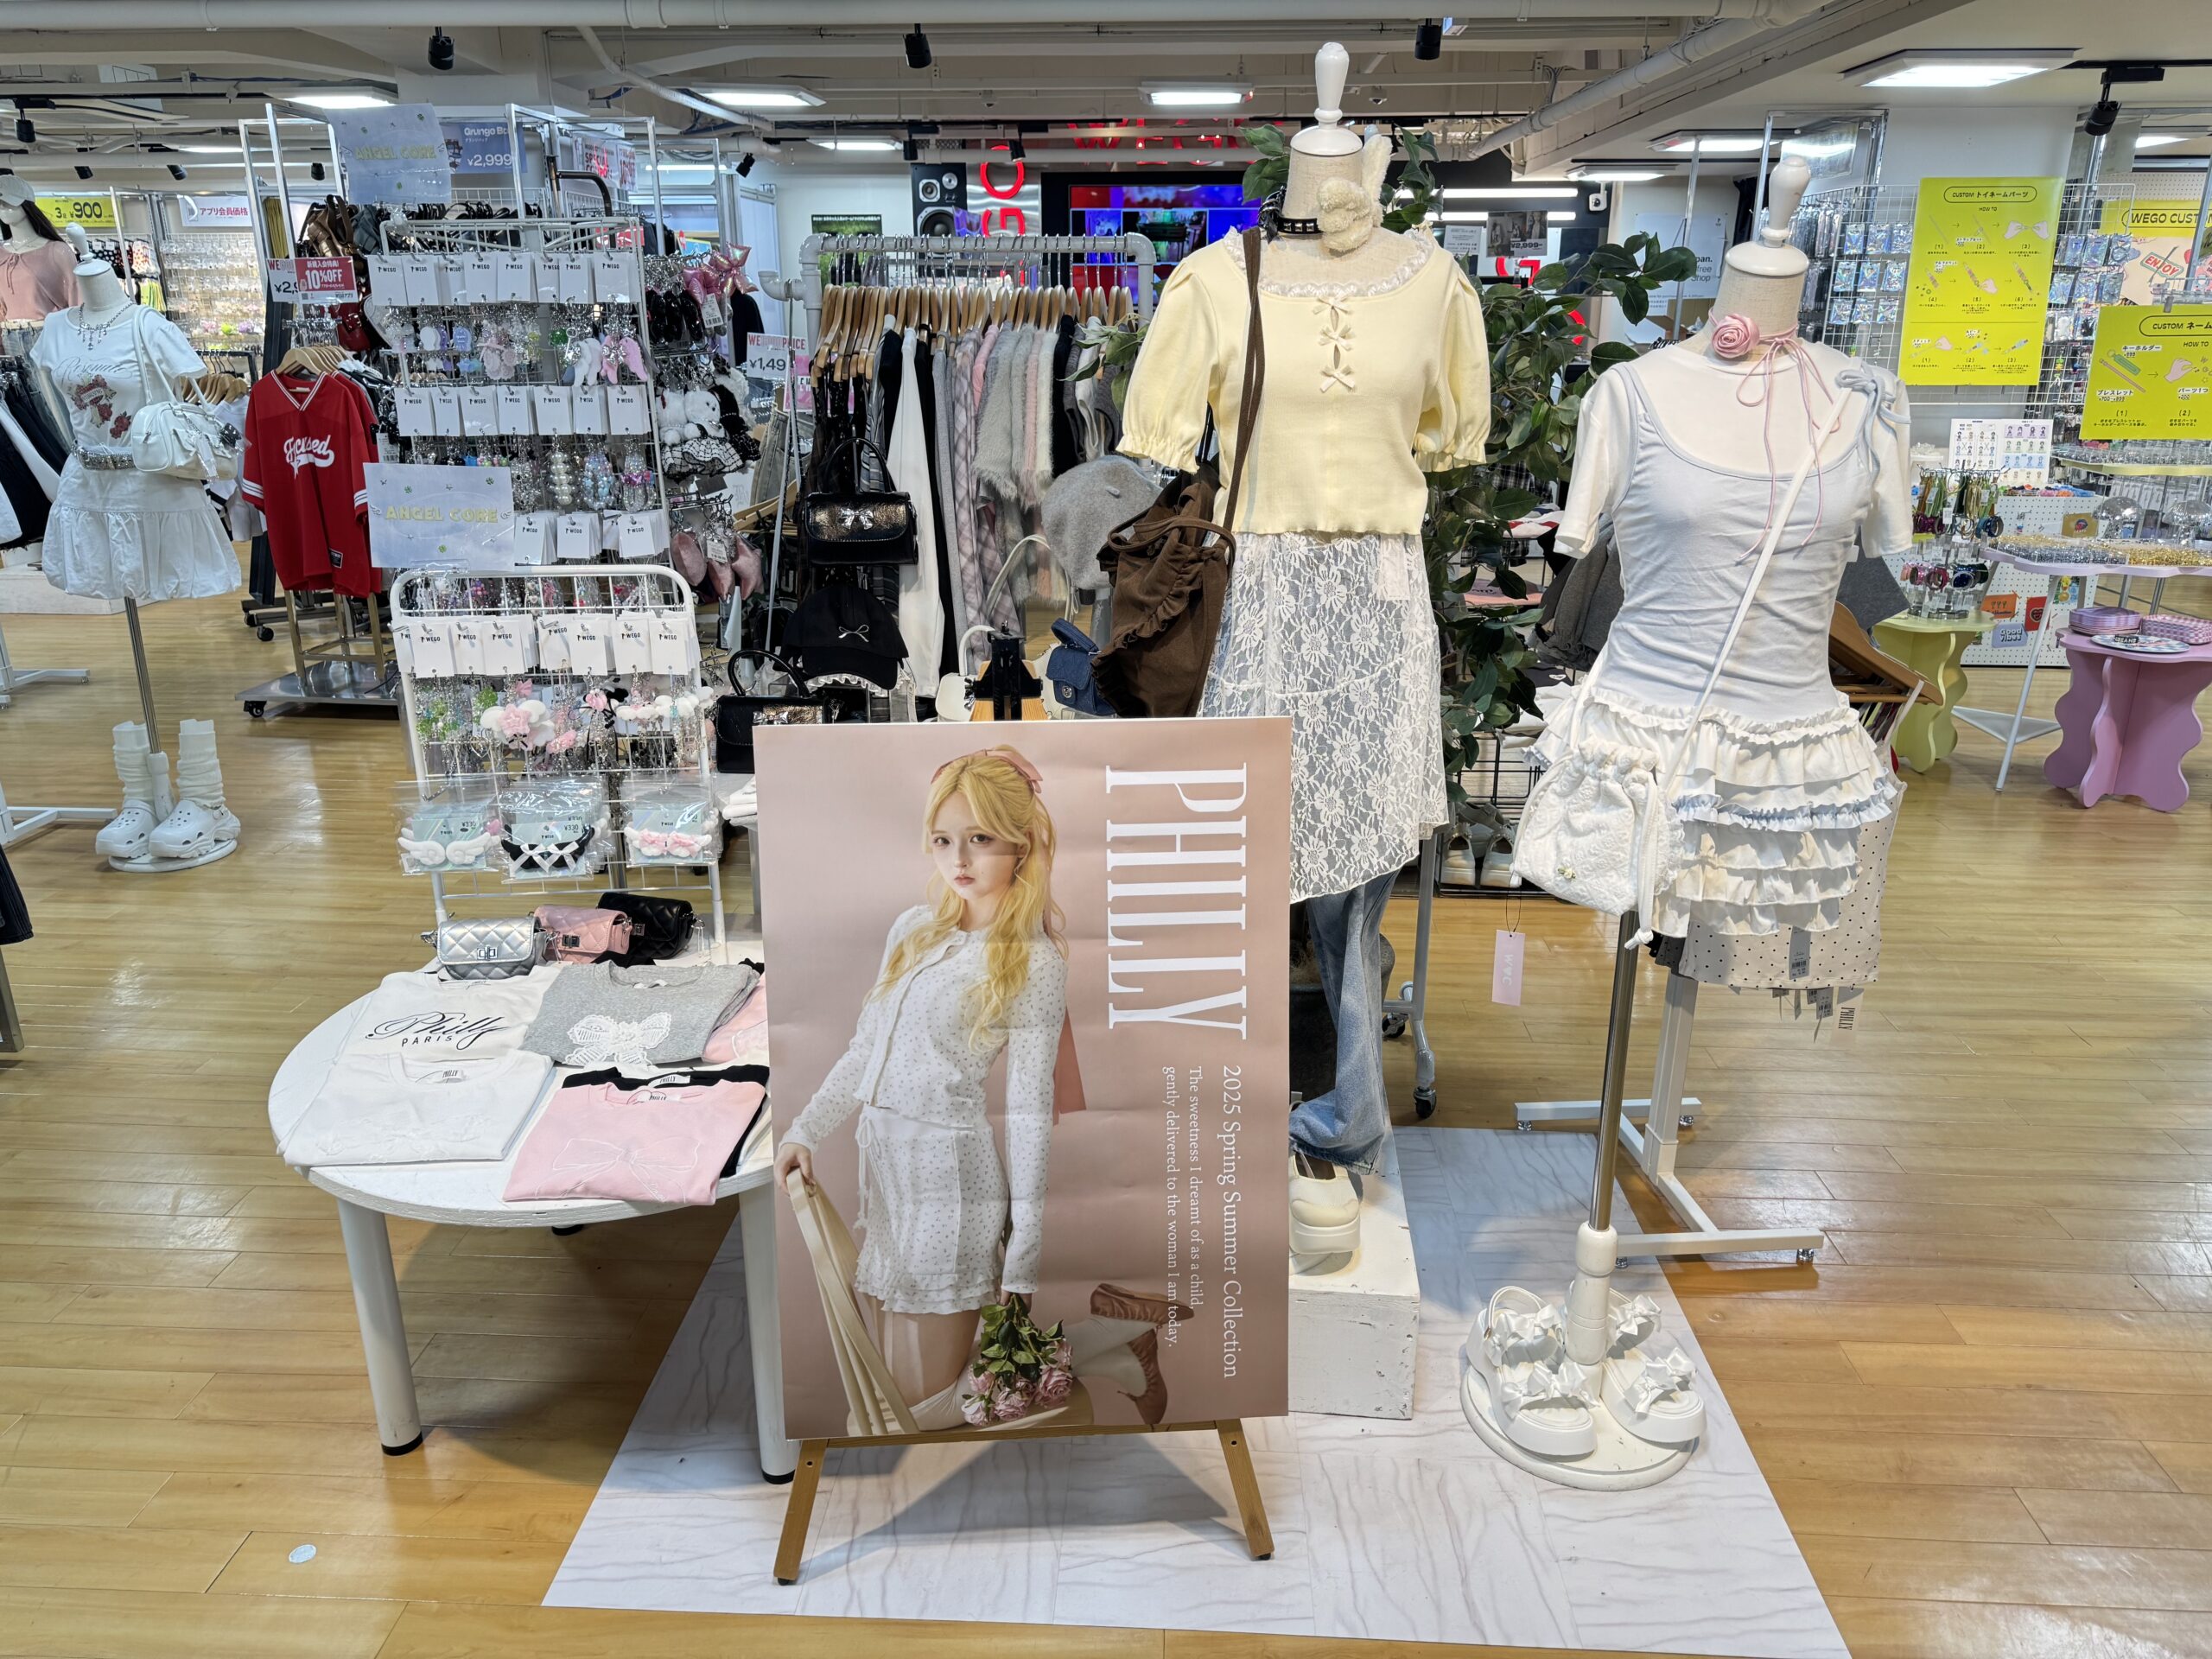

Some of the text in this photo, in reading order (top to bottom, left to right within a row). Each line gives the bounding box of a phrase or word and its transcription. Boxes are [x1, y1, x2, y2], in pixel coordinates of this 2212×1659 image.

[355, 145, 437, 160] ANGEL CORE
[467, 153, 513, 167] ¥2,999
[200, 207, 249, 217] アプリ会員価格
[2131, 213, 2212, 224] WEGO CUST
[2145, 255, 2179, 276] ENJOY
[305, 269, 343, 289] 10%OFF
[749, 357, 786, 372] ¥1,49
[385, 505, 499, 523] ANGEL CORE
[1105, 762, 1247, 1040] PHILLY
[1838, 1007, 1856, 1030] PHILLY
[365, 1011, 512, 1051] Philly
[401, 1036, 453, 1047] PARIS
[442, 1069, 459, 1078] PHILLY
[1189, 1065, 1203, 1092] The
[1162, 1066, 1180, 1108] gently
[1189, 1094, 1200, 1163] sweetness
[1166, 1109, 1180, 1175] delivered
[1166, 1177, 1179, 1192] to
[1166, 1193, 1180, 1217] the
[1190, 1175, 1203, 1226] dreamt
[1217, 1065, 1243, 1379] 2025 Spring Summer Collection
[1166, 1219, 1178, 1268] woman
[1190, 1229, 1205, 1244] of
[1190, 1246, 1199, 1261] as
[1167, 1280, 1178, 1304] am
[1188, 1273, 1204, 1310] child,
[1164, 1305, 1181, 1347] today.
